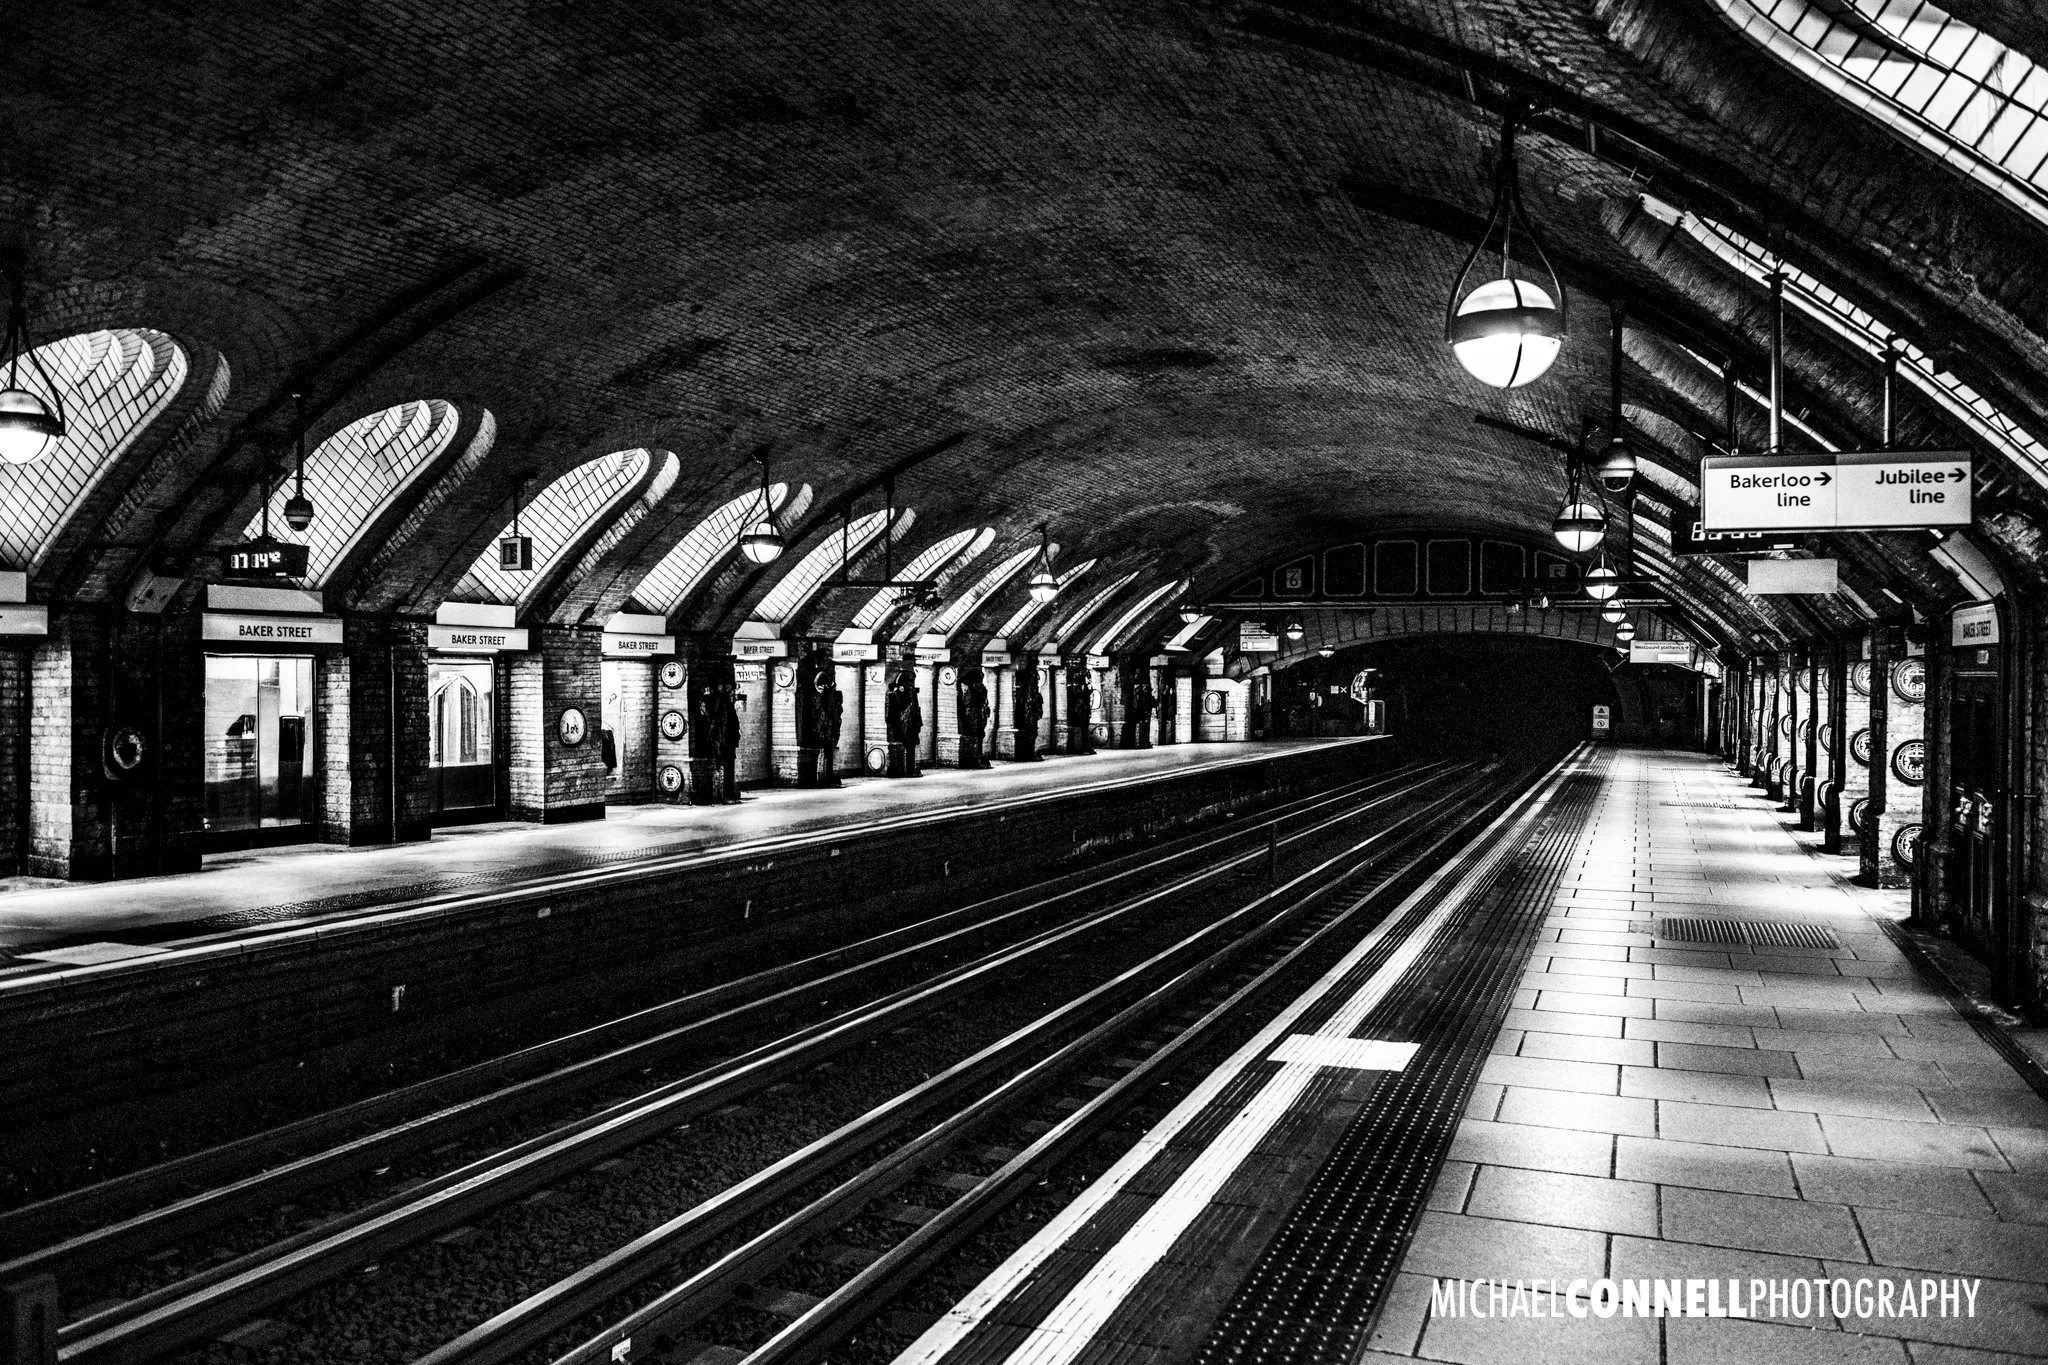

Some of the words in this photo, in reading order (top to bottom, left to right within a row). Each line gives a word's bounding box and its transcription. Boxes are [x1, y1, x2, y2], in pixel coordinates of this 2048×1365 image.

[1730, 473, 1811, 489] Bakerloo
[1875, 469, 1945, 486] Jubilee
[1777, 492, 1811, 507] line
[1910, 488, 1945, 504] line
[238, 625, 274, 638] BAKER
[276, 626, 313, 638] STREET
[1962, 622, 1976, 639] BAKER
[1976, 620, 1992, 637] STREET
[451, 634, 477, 646] BAKER
[479, 635, 506, 646] STREET
[618, 640, 638, 650] BAKER
[638, 641, 659, 651] STREET
[743, 645, 758, 655] BAKER
[759, 645, 775, 655] STREET
